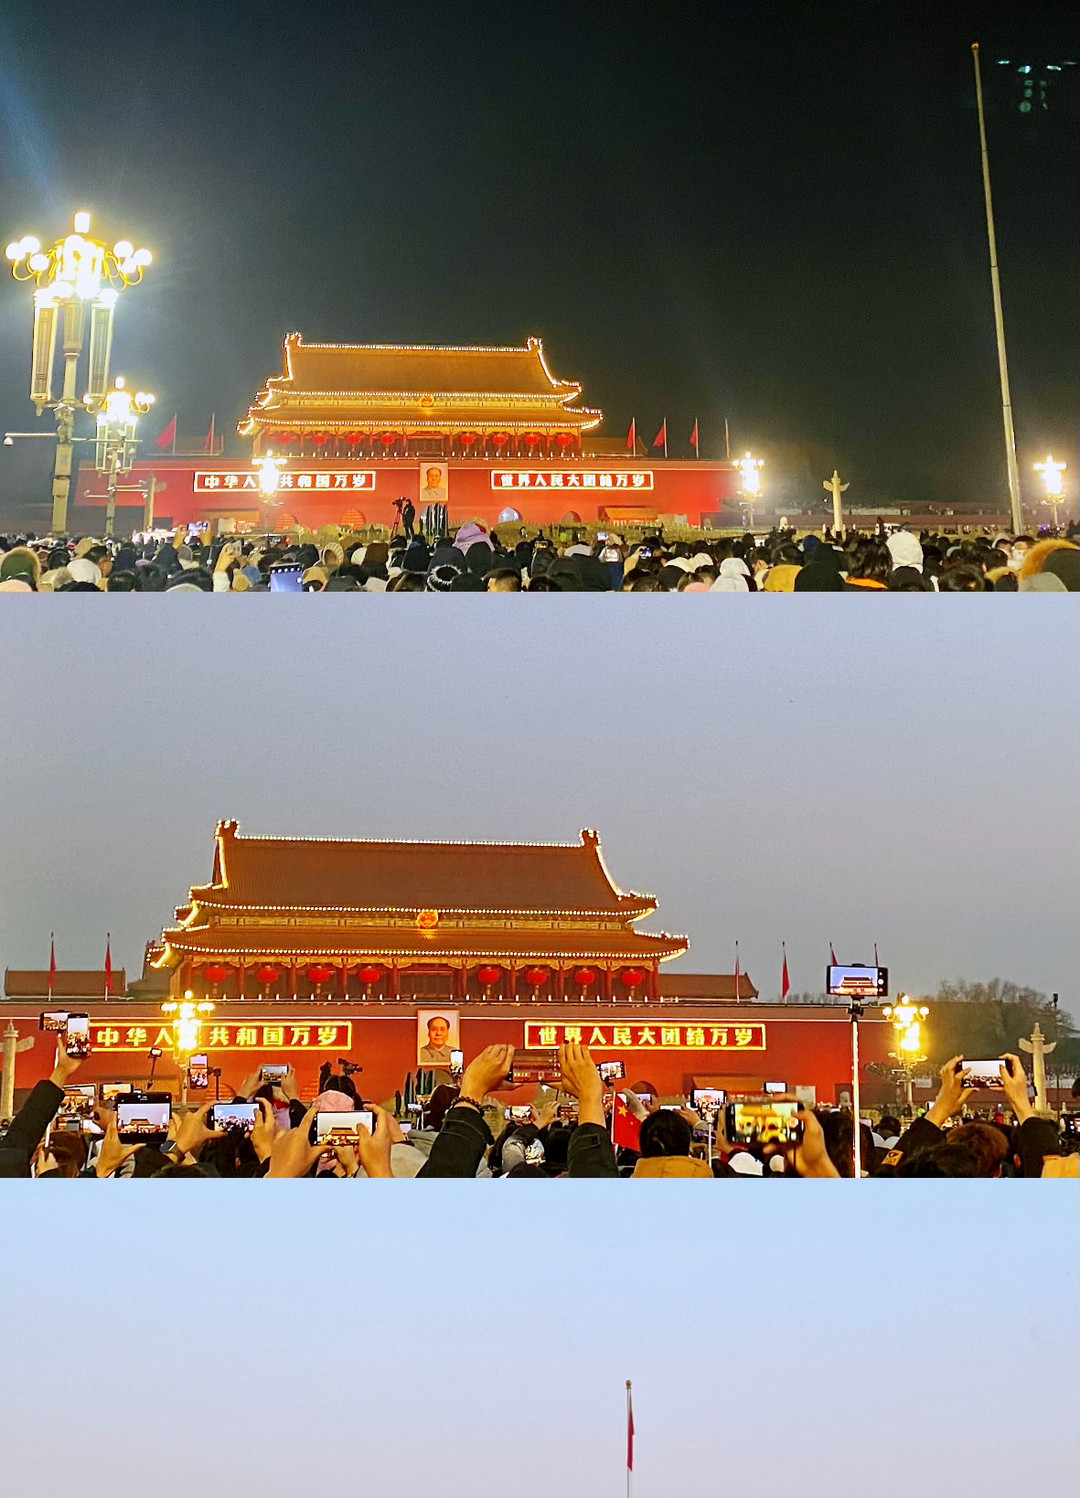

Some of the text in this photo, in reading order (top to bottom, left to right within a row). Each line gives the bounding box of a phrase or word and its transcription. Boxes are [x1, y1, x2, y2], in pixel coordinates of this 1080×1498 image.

[204, 475, 366, 489] 中华人共和国万岁
[97, 1027, 338, 1047] 中华人共和国万岁
[538, 1027, 753, 1046] 世界人民大团结万岁
